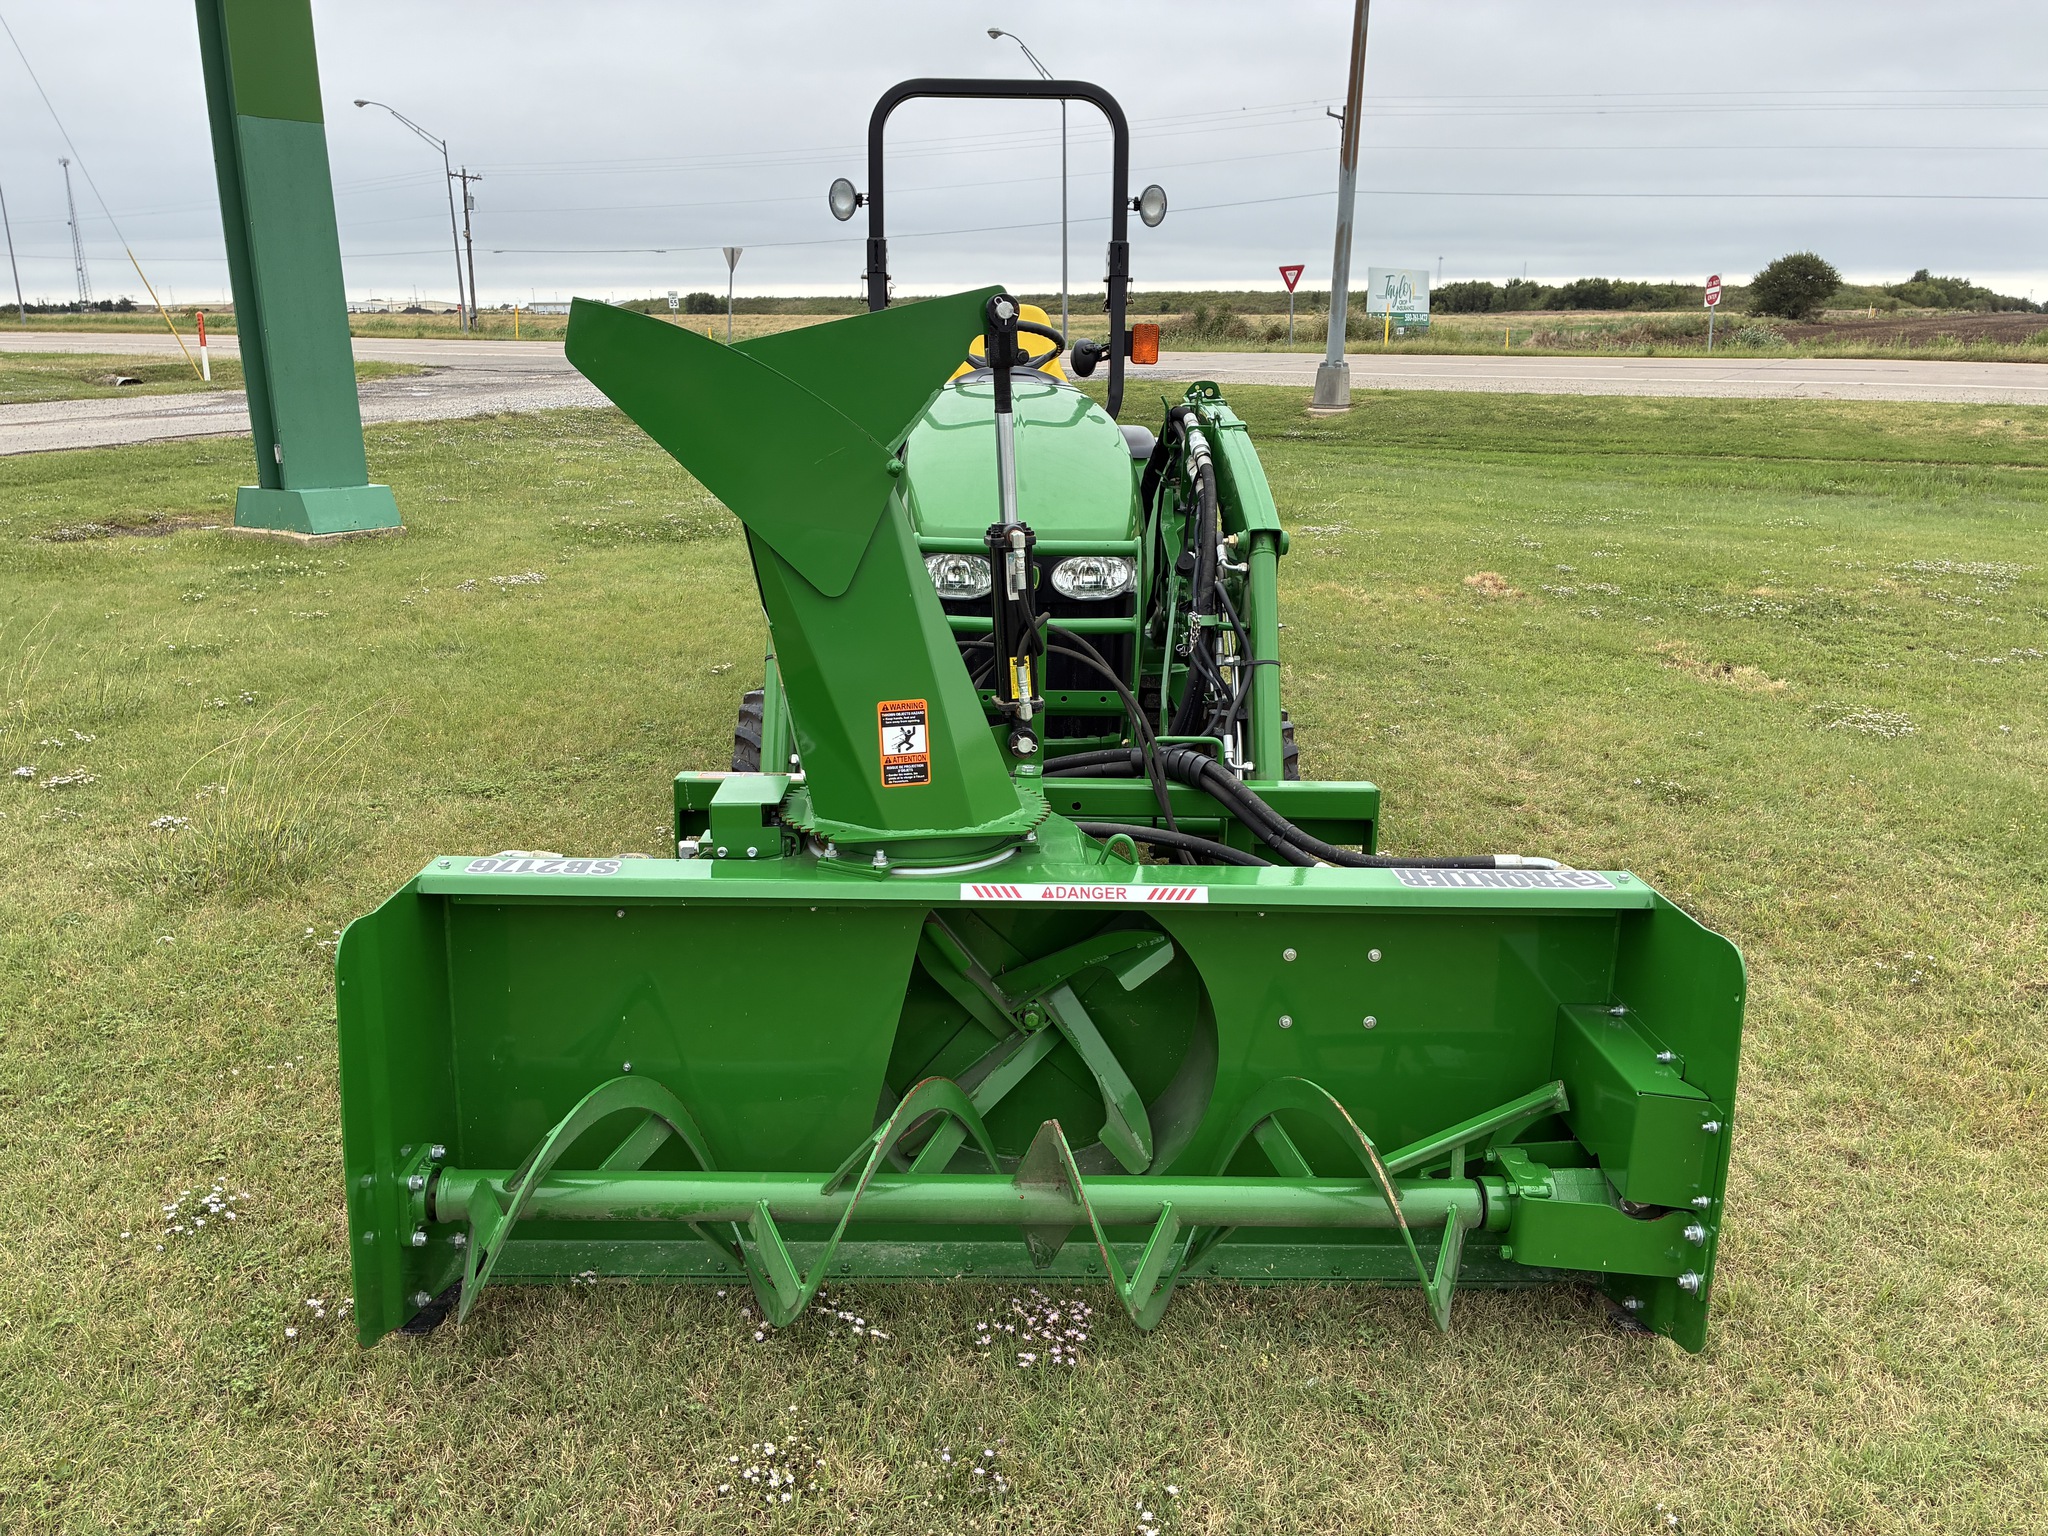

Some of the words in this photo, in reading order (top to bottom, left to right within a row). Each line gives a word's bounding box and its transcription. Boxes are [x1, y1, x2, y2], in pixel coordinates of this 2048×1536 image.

[1385, 275, 1412, 308] Taylor
[890, 702, 924, 710] WARNING
[893, 755, 926, 763] ATTENTION
[468, 860, 619, 874] SB2176
[1394, 870, 1580, 888] FRONTIER
[1056, 886, 1127, 900] DANGER
